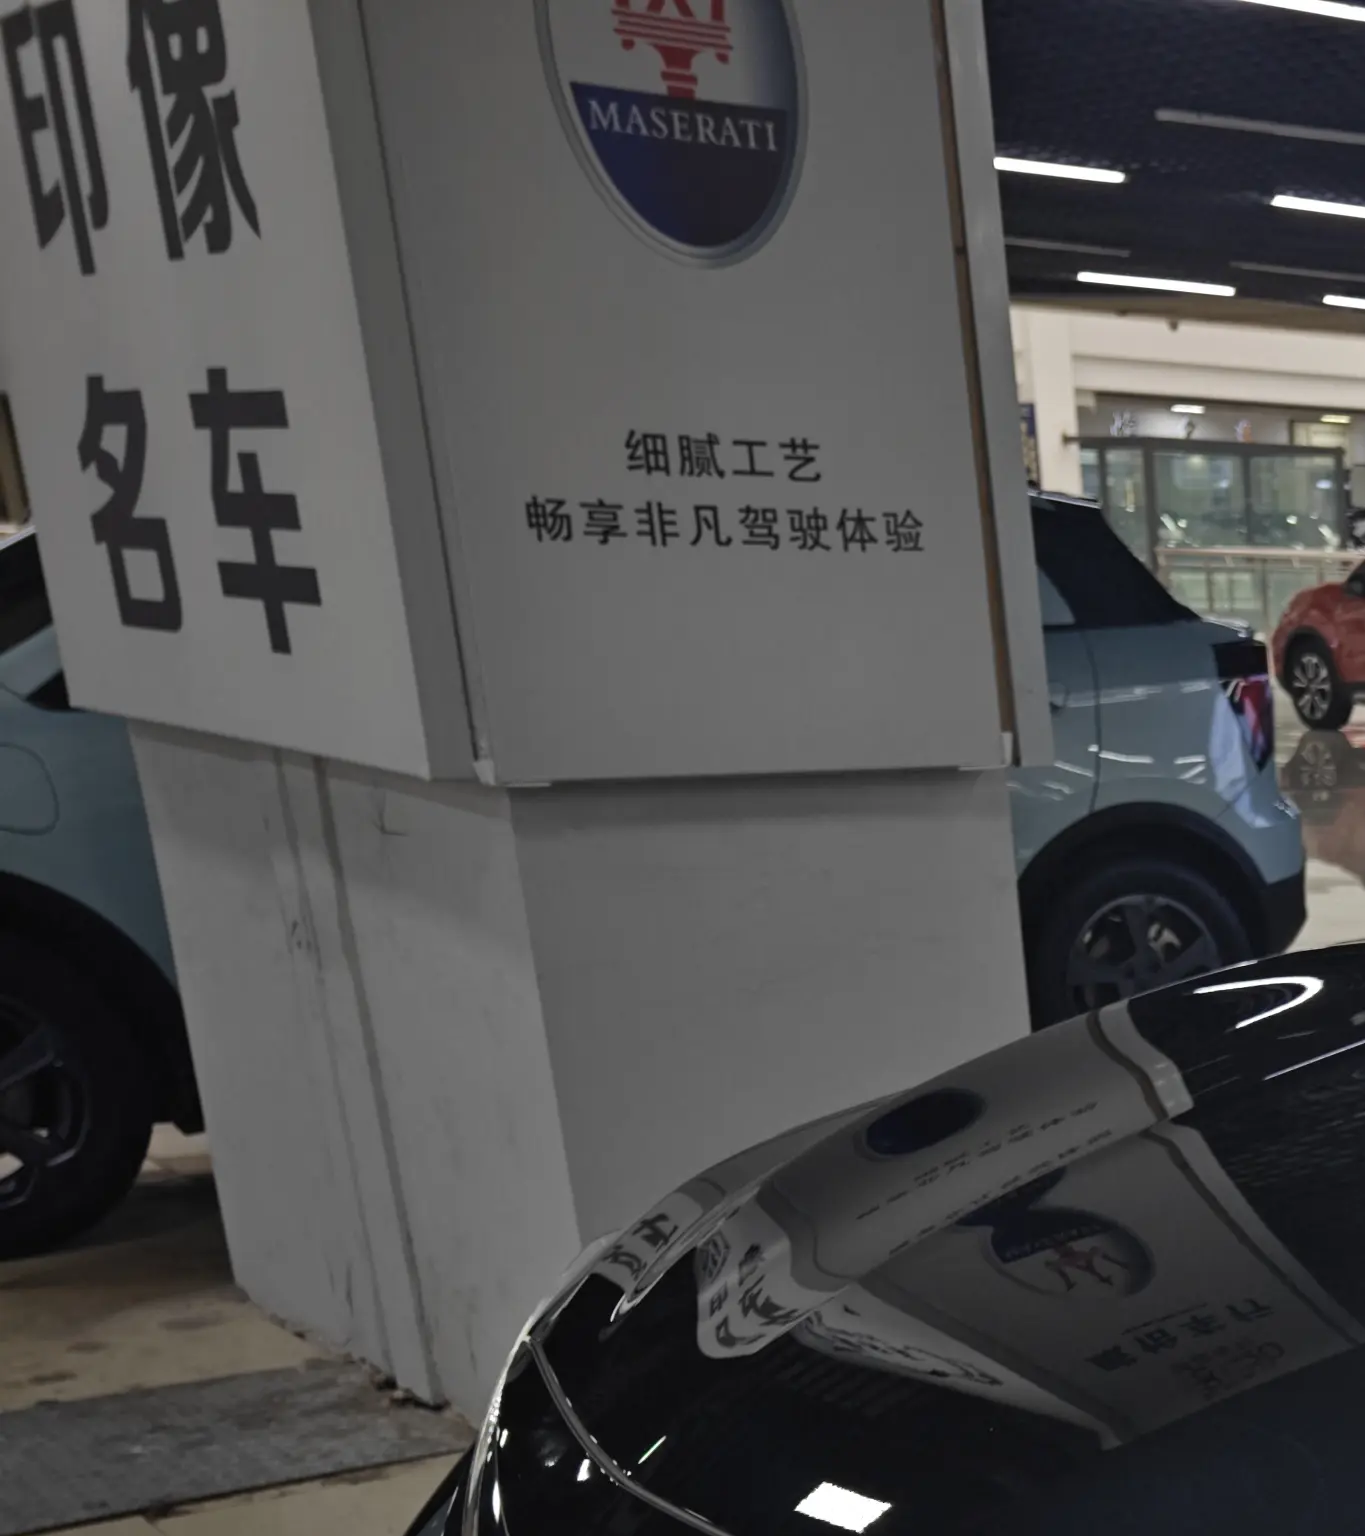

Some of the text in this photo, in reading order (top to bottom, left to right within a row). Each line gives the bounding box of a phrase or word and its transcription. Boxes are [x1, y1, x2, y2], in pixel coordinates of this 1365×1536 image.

[588, 99, 778, 153] MASERATI
[624, 428, 822, 483] 细腻工艺
[77, 367, 322, 655] 名车
[524, 494, 925, 553] 畅享非凡驾驶体验
